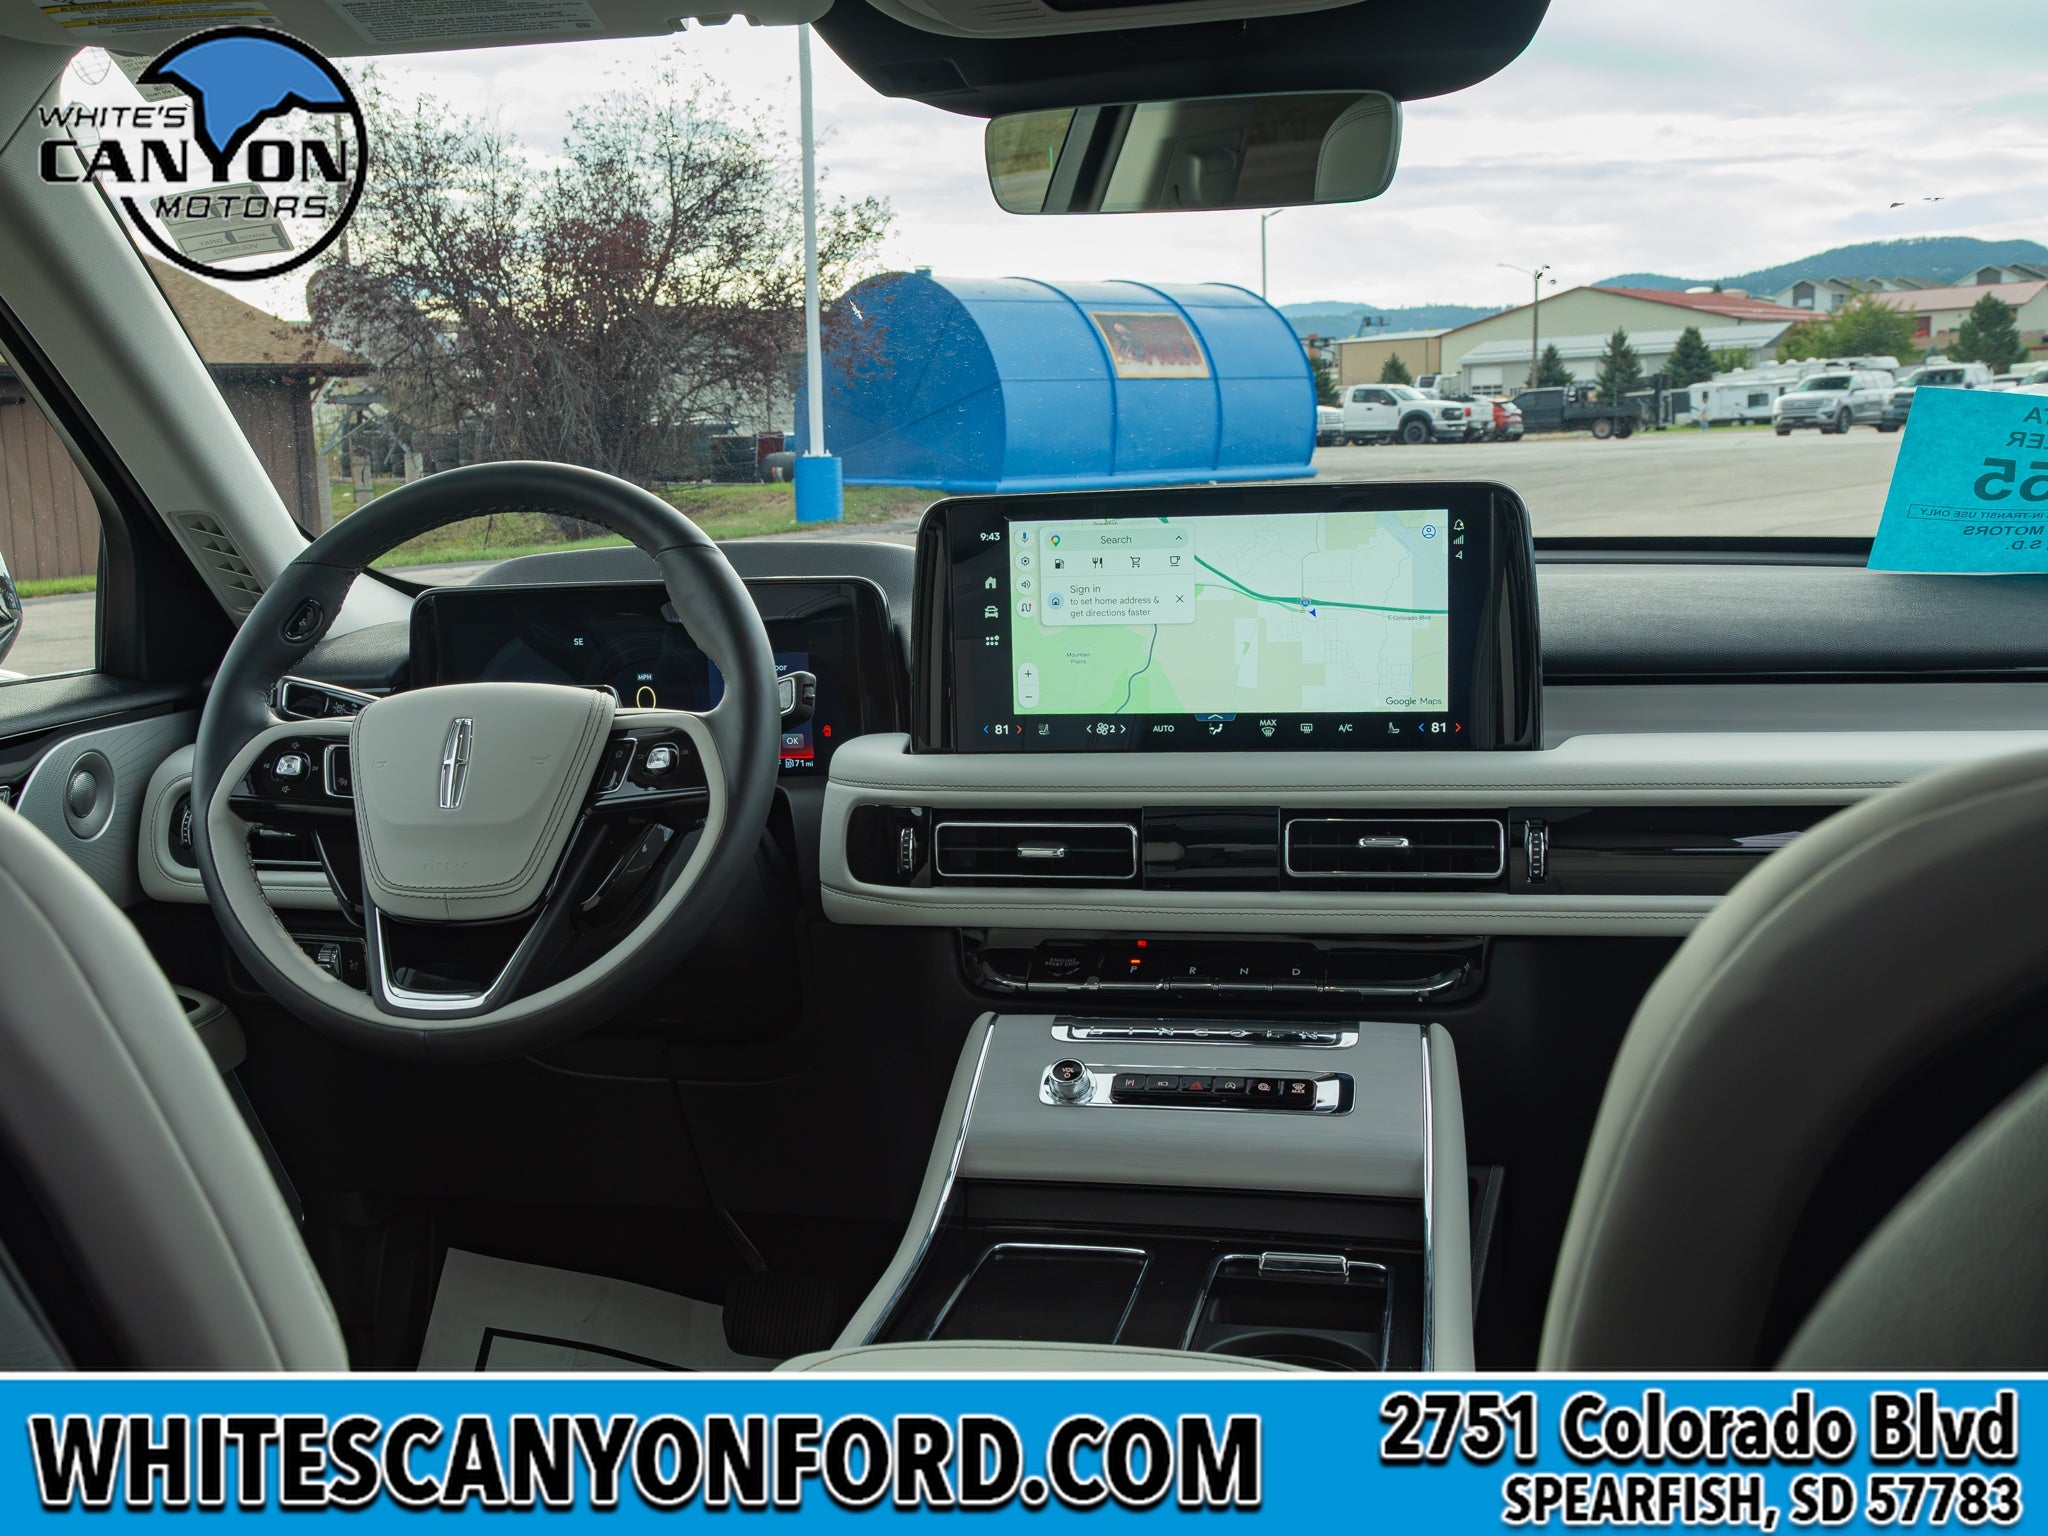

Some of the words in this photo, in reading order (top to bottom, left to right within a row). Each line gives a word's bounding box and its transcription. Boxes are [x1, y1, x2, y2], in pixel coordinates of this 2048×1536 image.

[980, 532, 1001, 541] 9:43
[1100, 535, 1132, 544] Search
[1070, 585, 1089, 595] Sign
[1092, 585, 1101, 593] in
[1070, 597, 1078, 605] to
[1080, 597, 1093, 605] set
[1094, 597, 1117, 605] home
[1119, 596, 1151, 605] address
[1154, 596, 1160, 604] &
[1070, 609, 1084, 619] get
[1085, 608, 1126, 617] directions
[1127, 608, 1151, 617] faster
[573, 638, 584, 646] SE
[637, 673, 652, 681] MPH
[1386, 697, 1417, 707] Google
[1420, 697, 1442, 706] Maps
[994, 724, 1009, 735] 81
[1109, 725, 1116, 733] 2
[1153, 725, 1175, 733] AUTO
[1338, 724, 1353, 732] A/C
[1431, 722, 1447, 732] 81
[786, 737, 799, 745] OK
[795, 759, 805, 767] 71
[1189, 966, 1197, 975] R
[1239, 967, 1249, 975] N
[1291, 968, 1301, 976] D
[1089, 1026, 1319, 1040] LINCOLN
